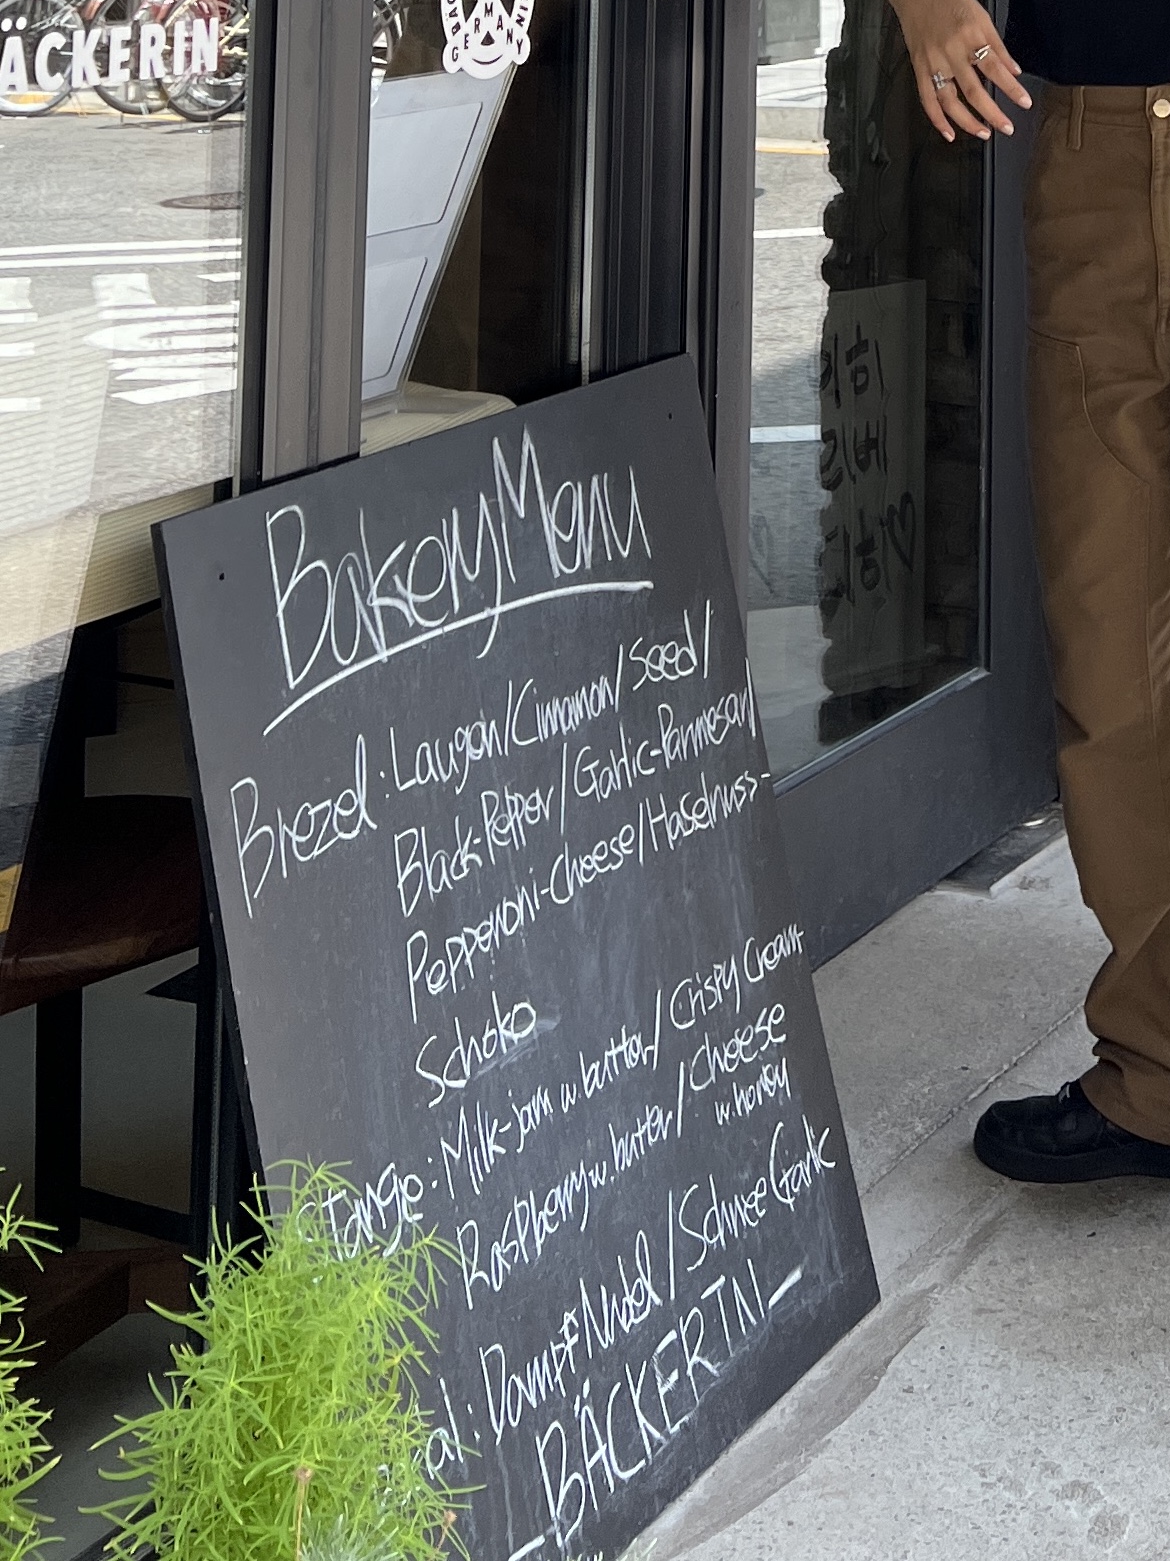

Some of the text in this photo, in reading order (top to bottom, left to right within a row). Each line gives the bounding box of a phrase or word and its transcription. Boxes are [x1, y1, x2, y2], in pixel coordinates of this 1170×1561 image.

[451, 2, 524, 62] GERMANY
[265, 423, 652, 689] Bakery Menu
[415, 991, 537, 1107] Schoko
